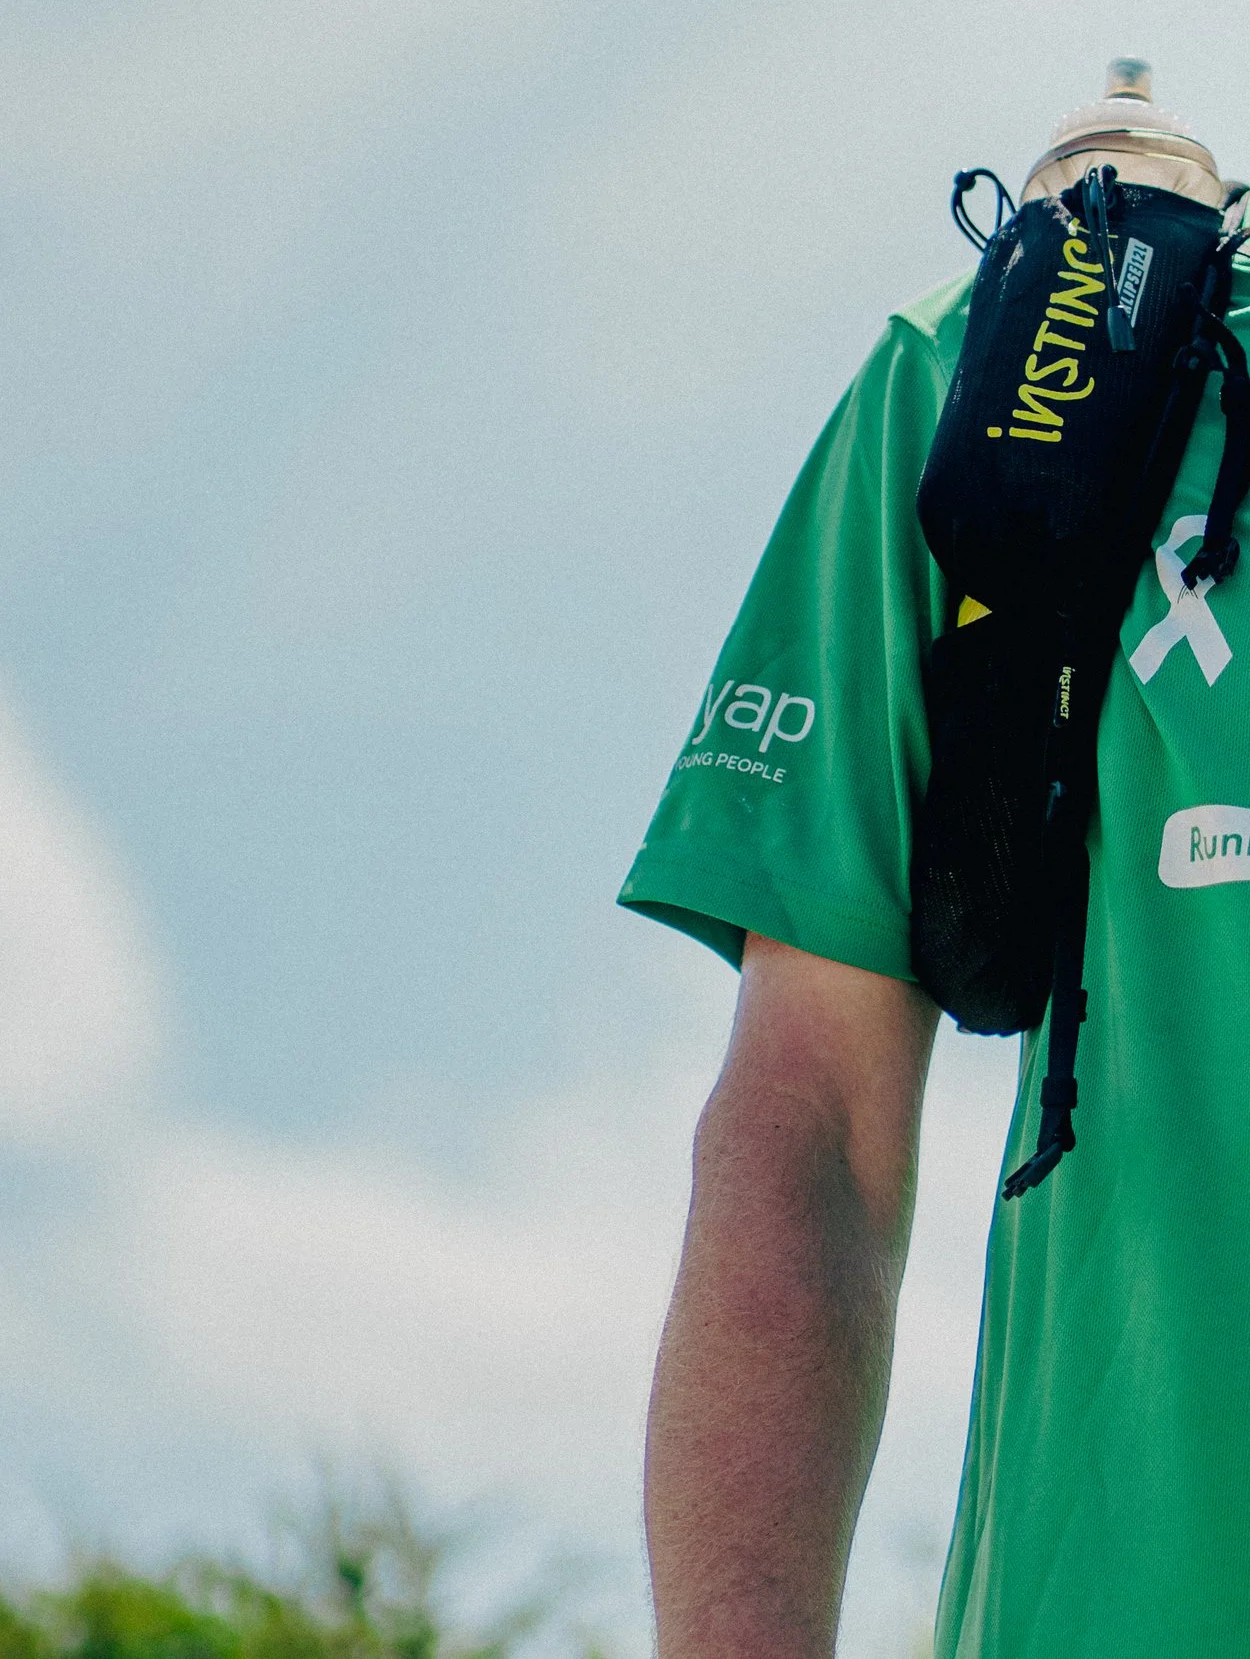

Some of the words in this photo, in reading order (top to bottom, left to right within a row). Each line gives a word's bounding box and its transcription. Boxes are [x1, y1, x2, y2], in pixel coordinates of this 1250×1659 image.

[691, 679, 816, 754] yap
[675, 751, 714, 771] OUNG
[714, 752, 787, 784] PEOPLE
